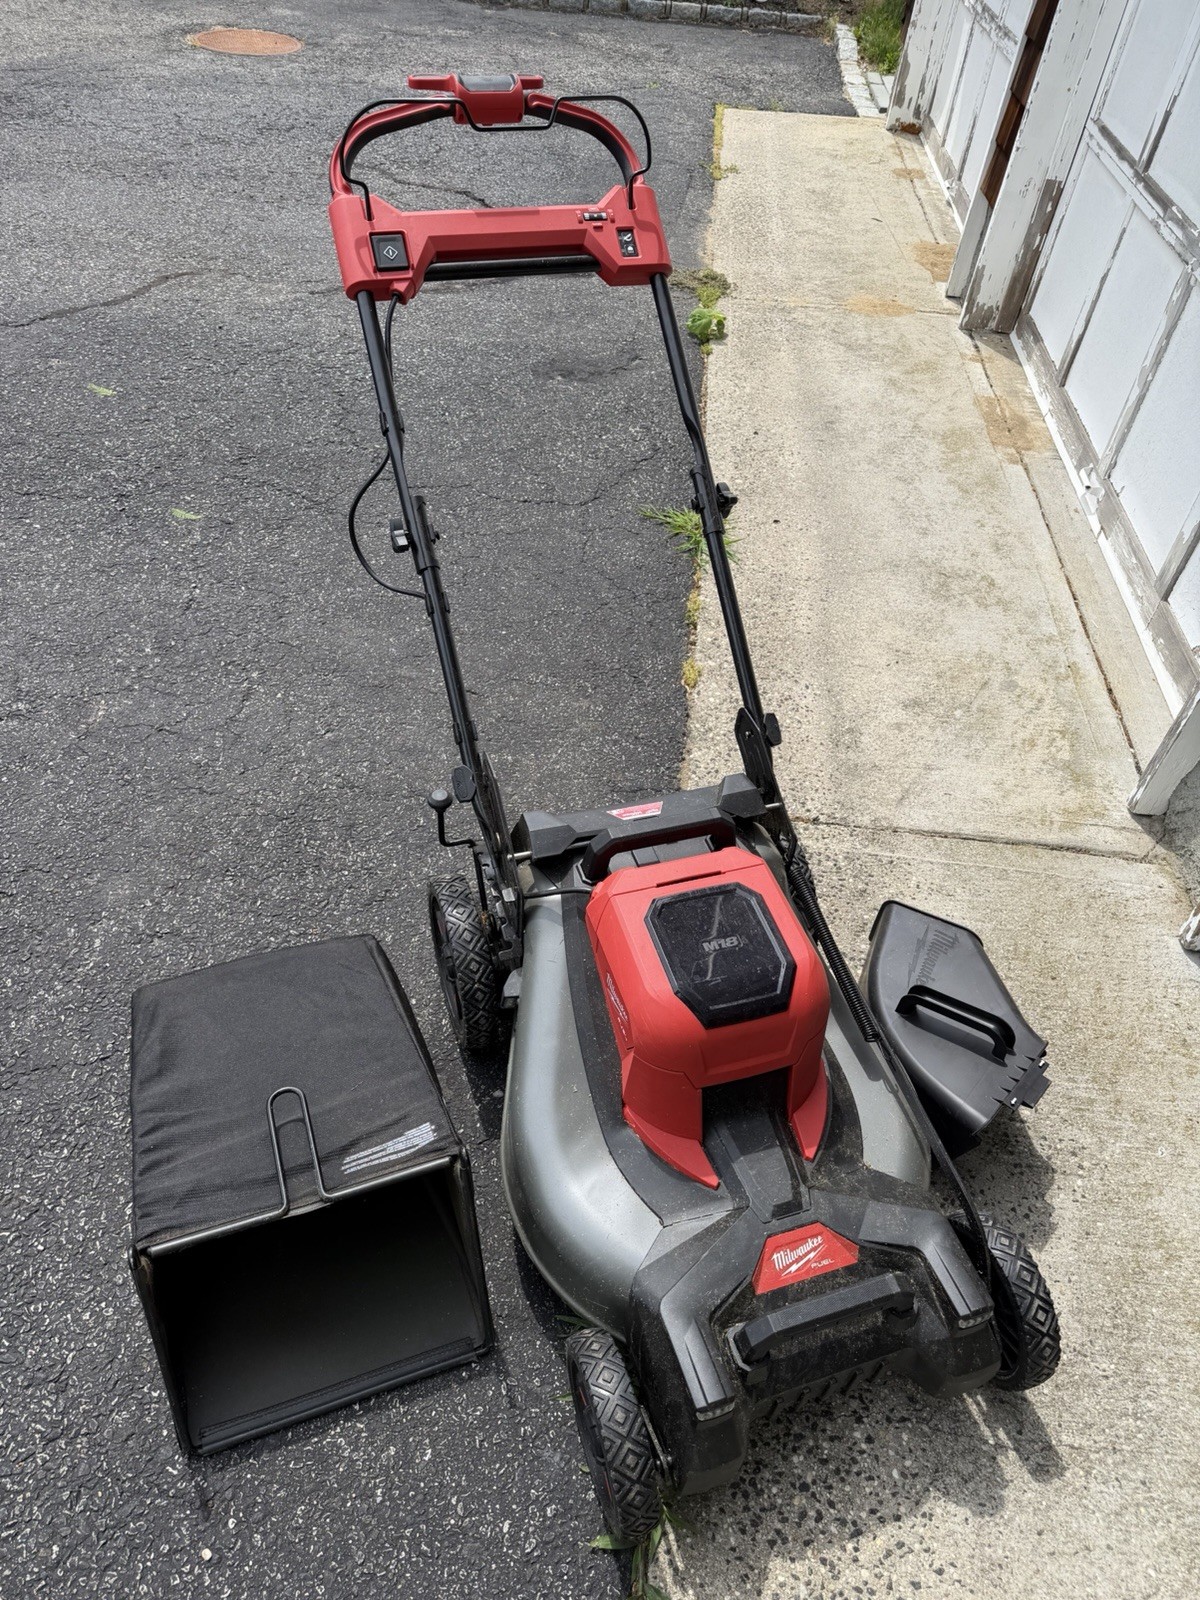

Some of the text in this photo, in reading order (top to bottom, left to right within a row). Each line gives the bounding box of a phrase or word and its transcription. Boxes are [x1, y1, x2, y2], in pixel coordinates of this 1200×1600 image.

[702, 936, 739, 952] M18
[915, 928, 960, 985] Milwauke
[771, 1235, 824, 1271] Milwaukee
[811, 1258, 835, 1269] FUEL
